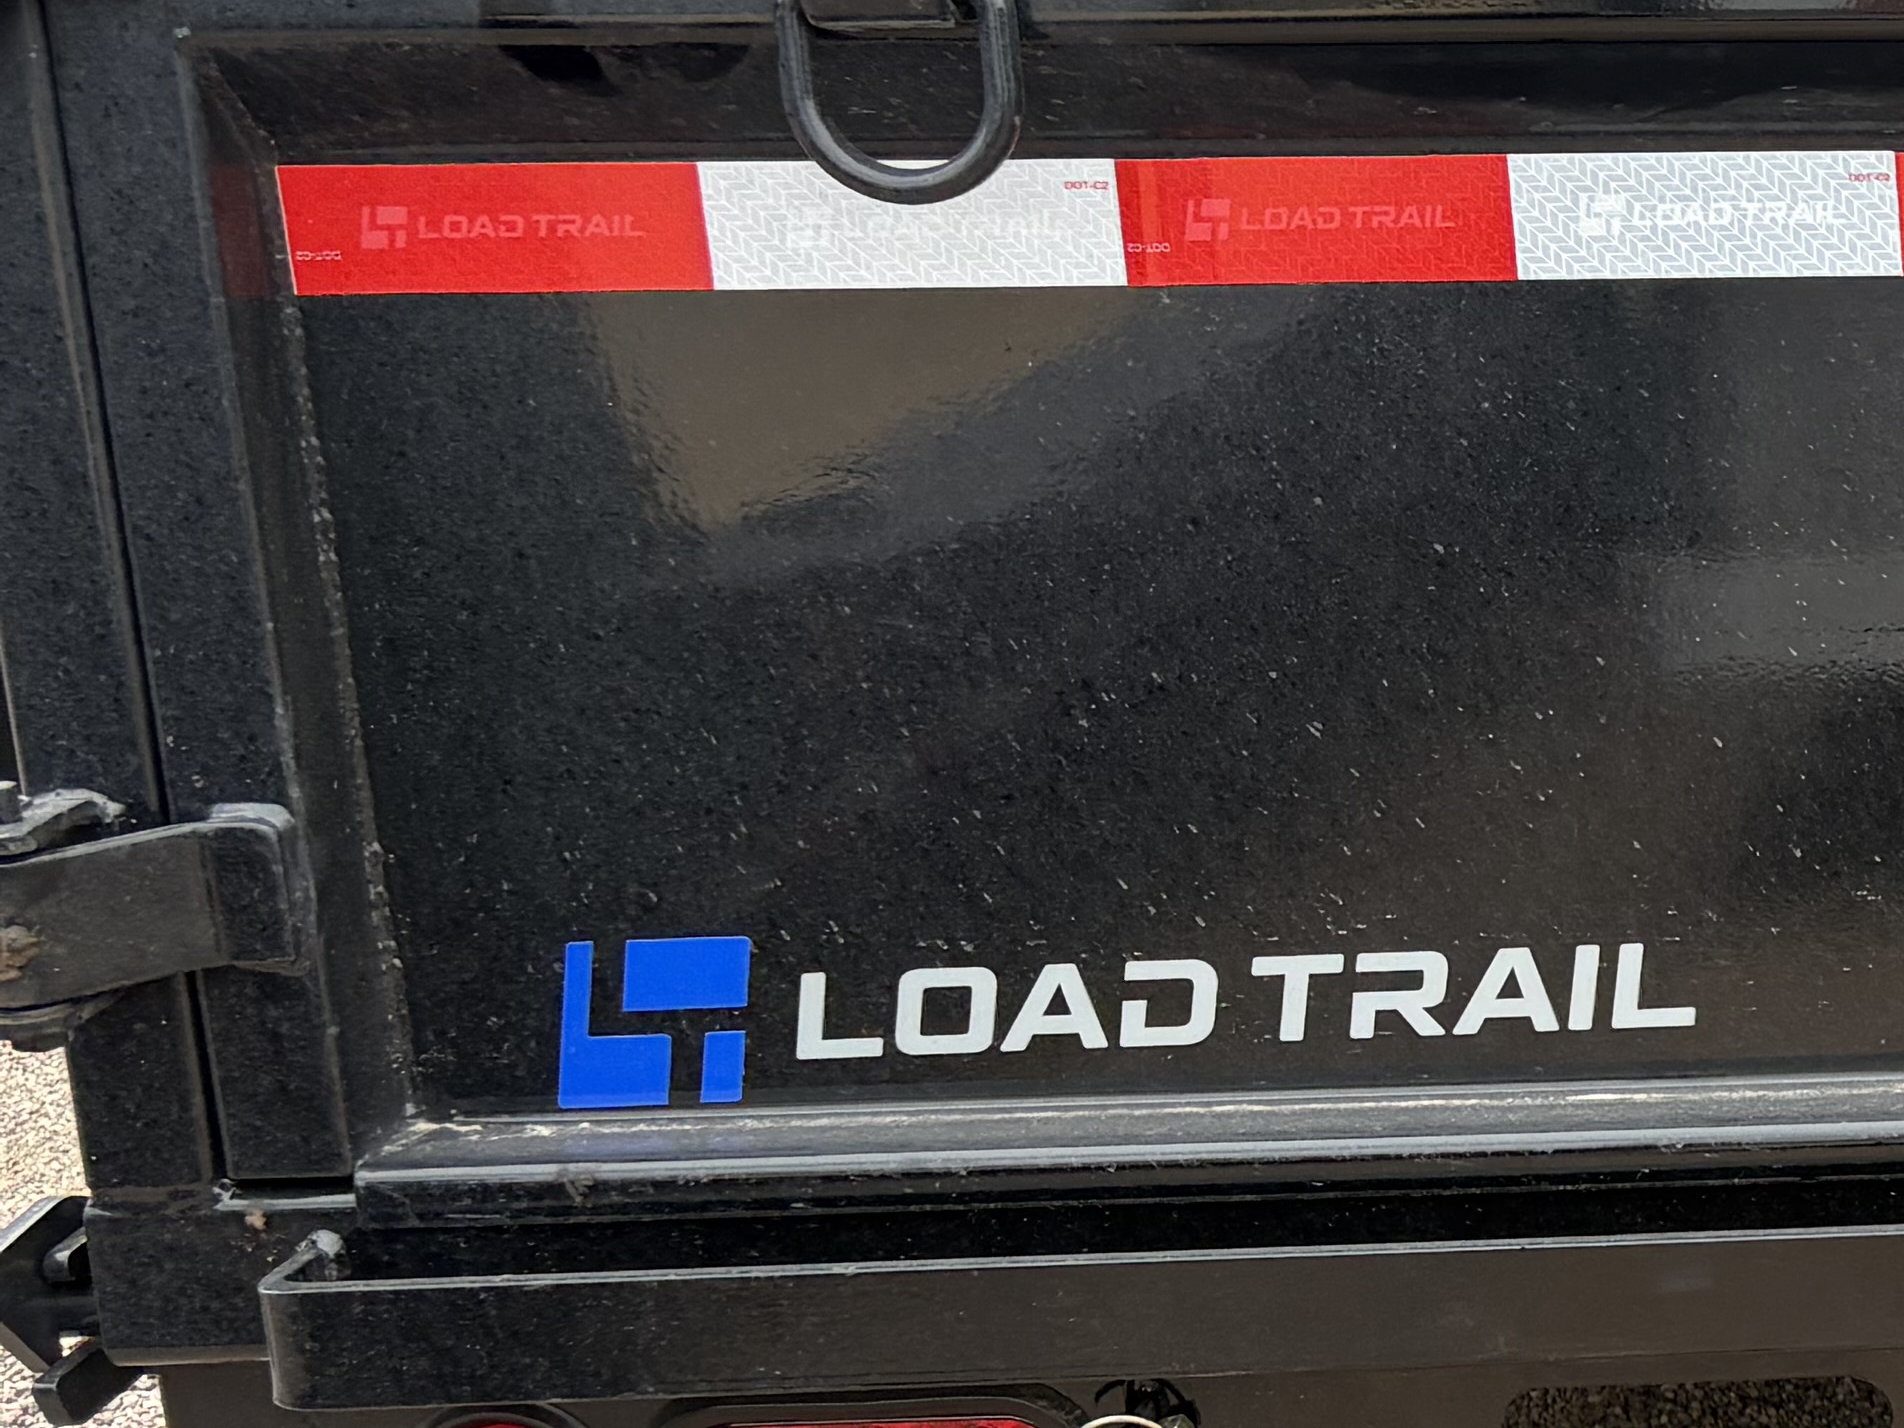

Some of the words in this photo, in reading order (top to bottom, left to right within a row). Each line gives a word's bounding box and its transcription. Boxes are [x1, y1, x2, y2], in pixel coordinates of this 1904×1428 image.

[418, 215, 524, 239] LOAD
[531, 214, 646, 238] TRAIL
[1242, 207, 1340, 230] LOAD
[1349, 205, 1456, 228] TRAIL
[796, 959, 1218, 1060] LOAD
[1251, 942, 1696, 1043] TRAIL
